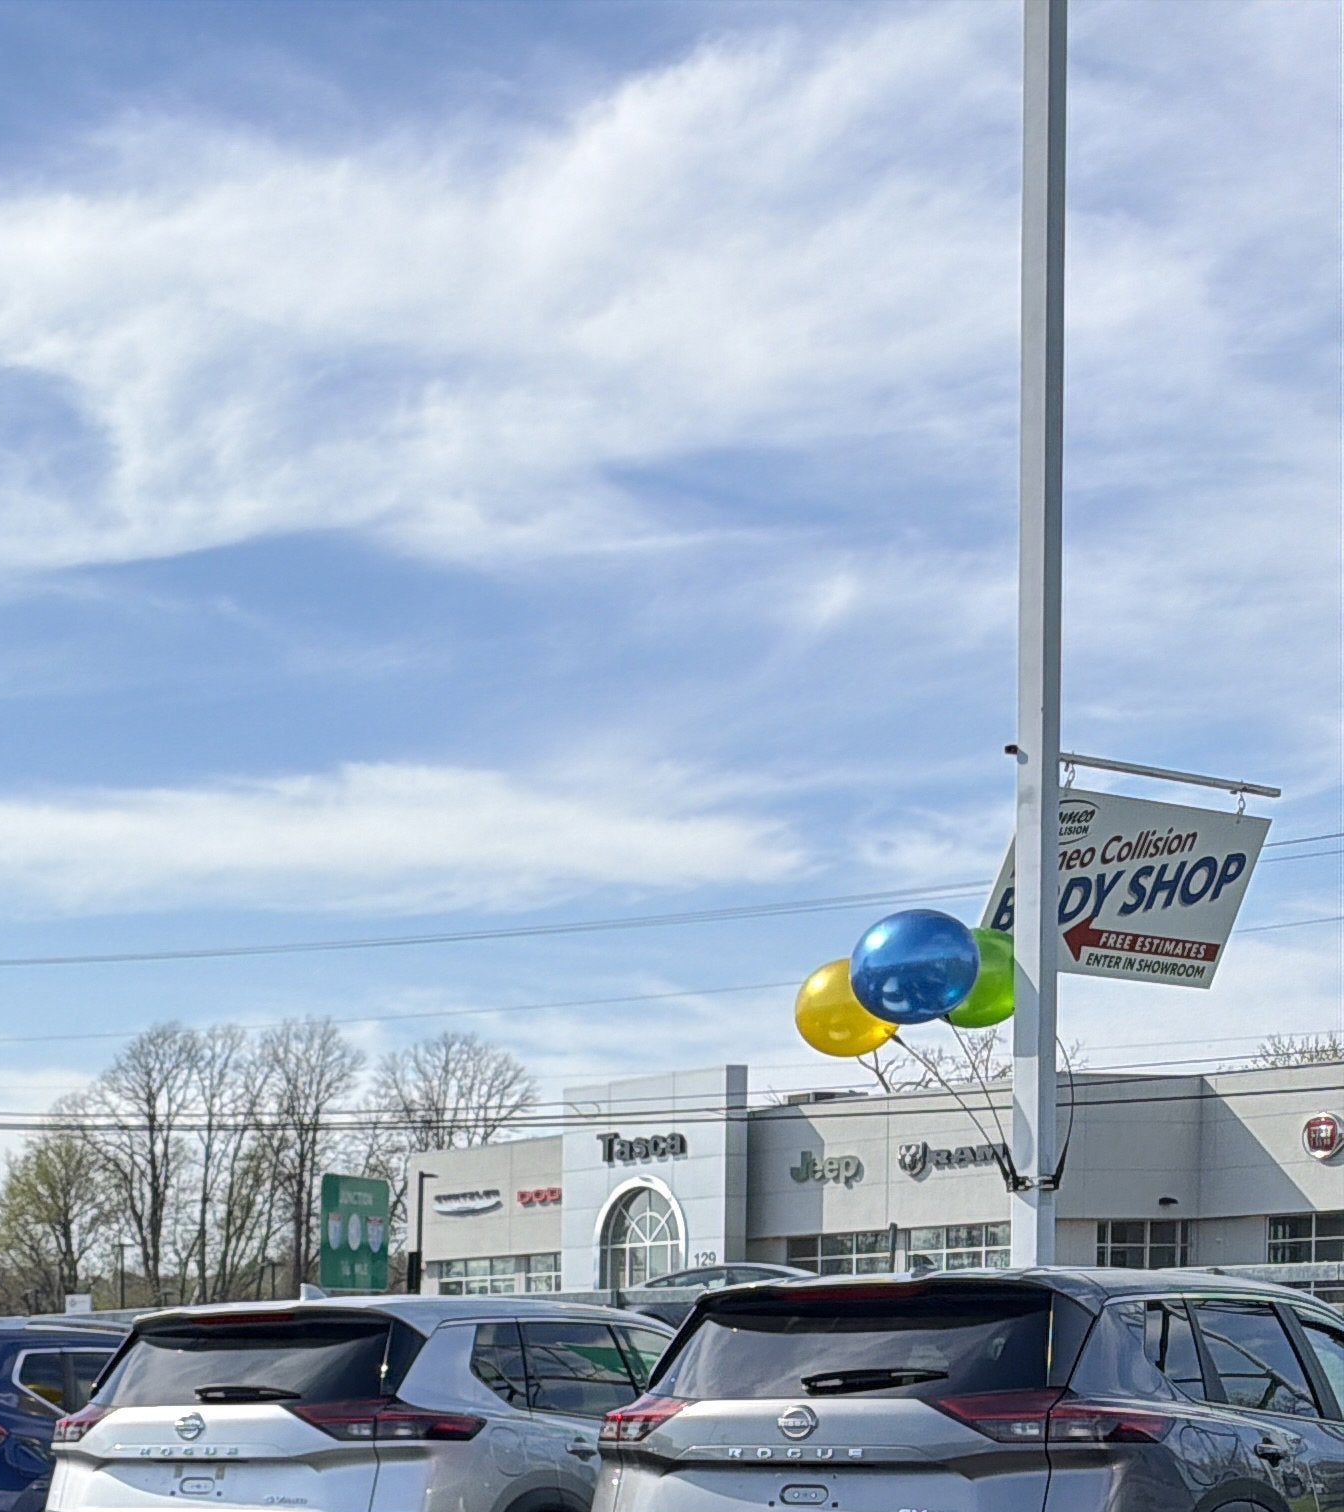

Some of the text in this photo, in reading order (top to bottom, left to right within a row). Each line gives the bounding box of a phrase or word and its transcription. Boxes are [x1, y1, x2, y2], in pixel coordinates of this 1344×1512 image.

[1101, 827, 1198, 865] Collision
[991, 852, 1247, 932] BDY SHOP
[1099, 932, 1207, 959] FREE ESTIMATES
[1085, 952, 1206, 979] ENTER IN SHOWROOM
[596, 1132, 688, 1163] Tasca
[927, 1143, 1009, 1167] RAM
[791, 1150, 862, 1187] Jeep
[694, 1251, 717, 1267] 129
[728, 1448, 863, 1459] ROGUE
